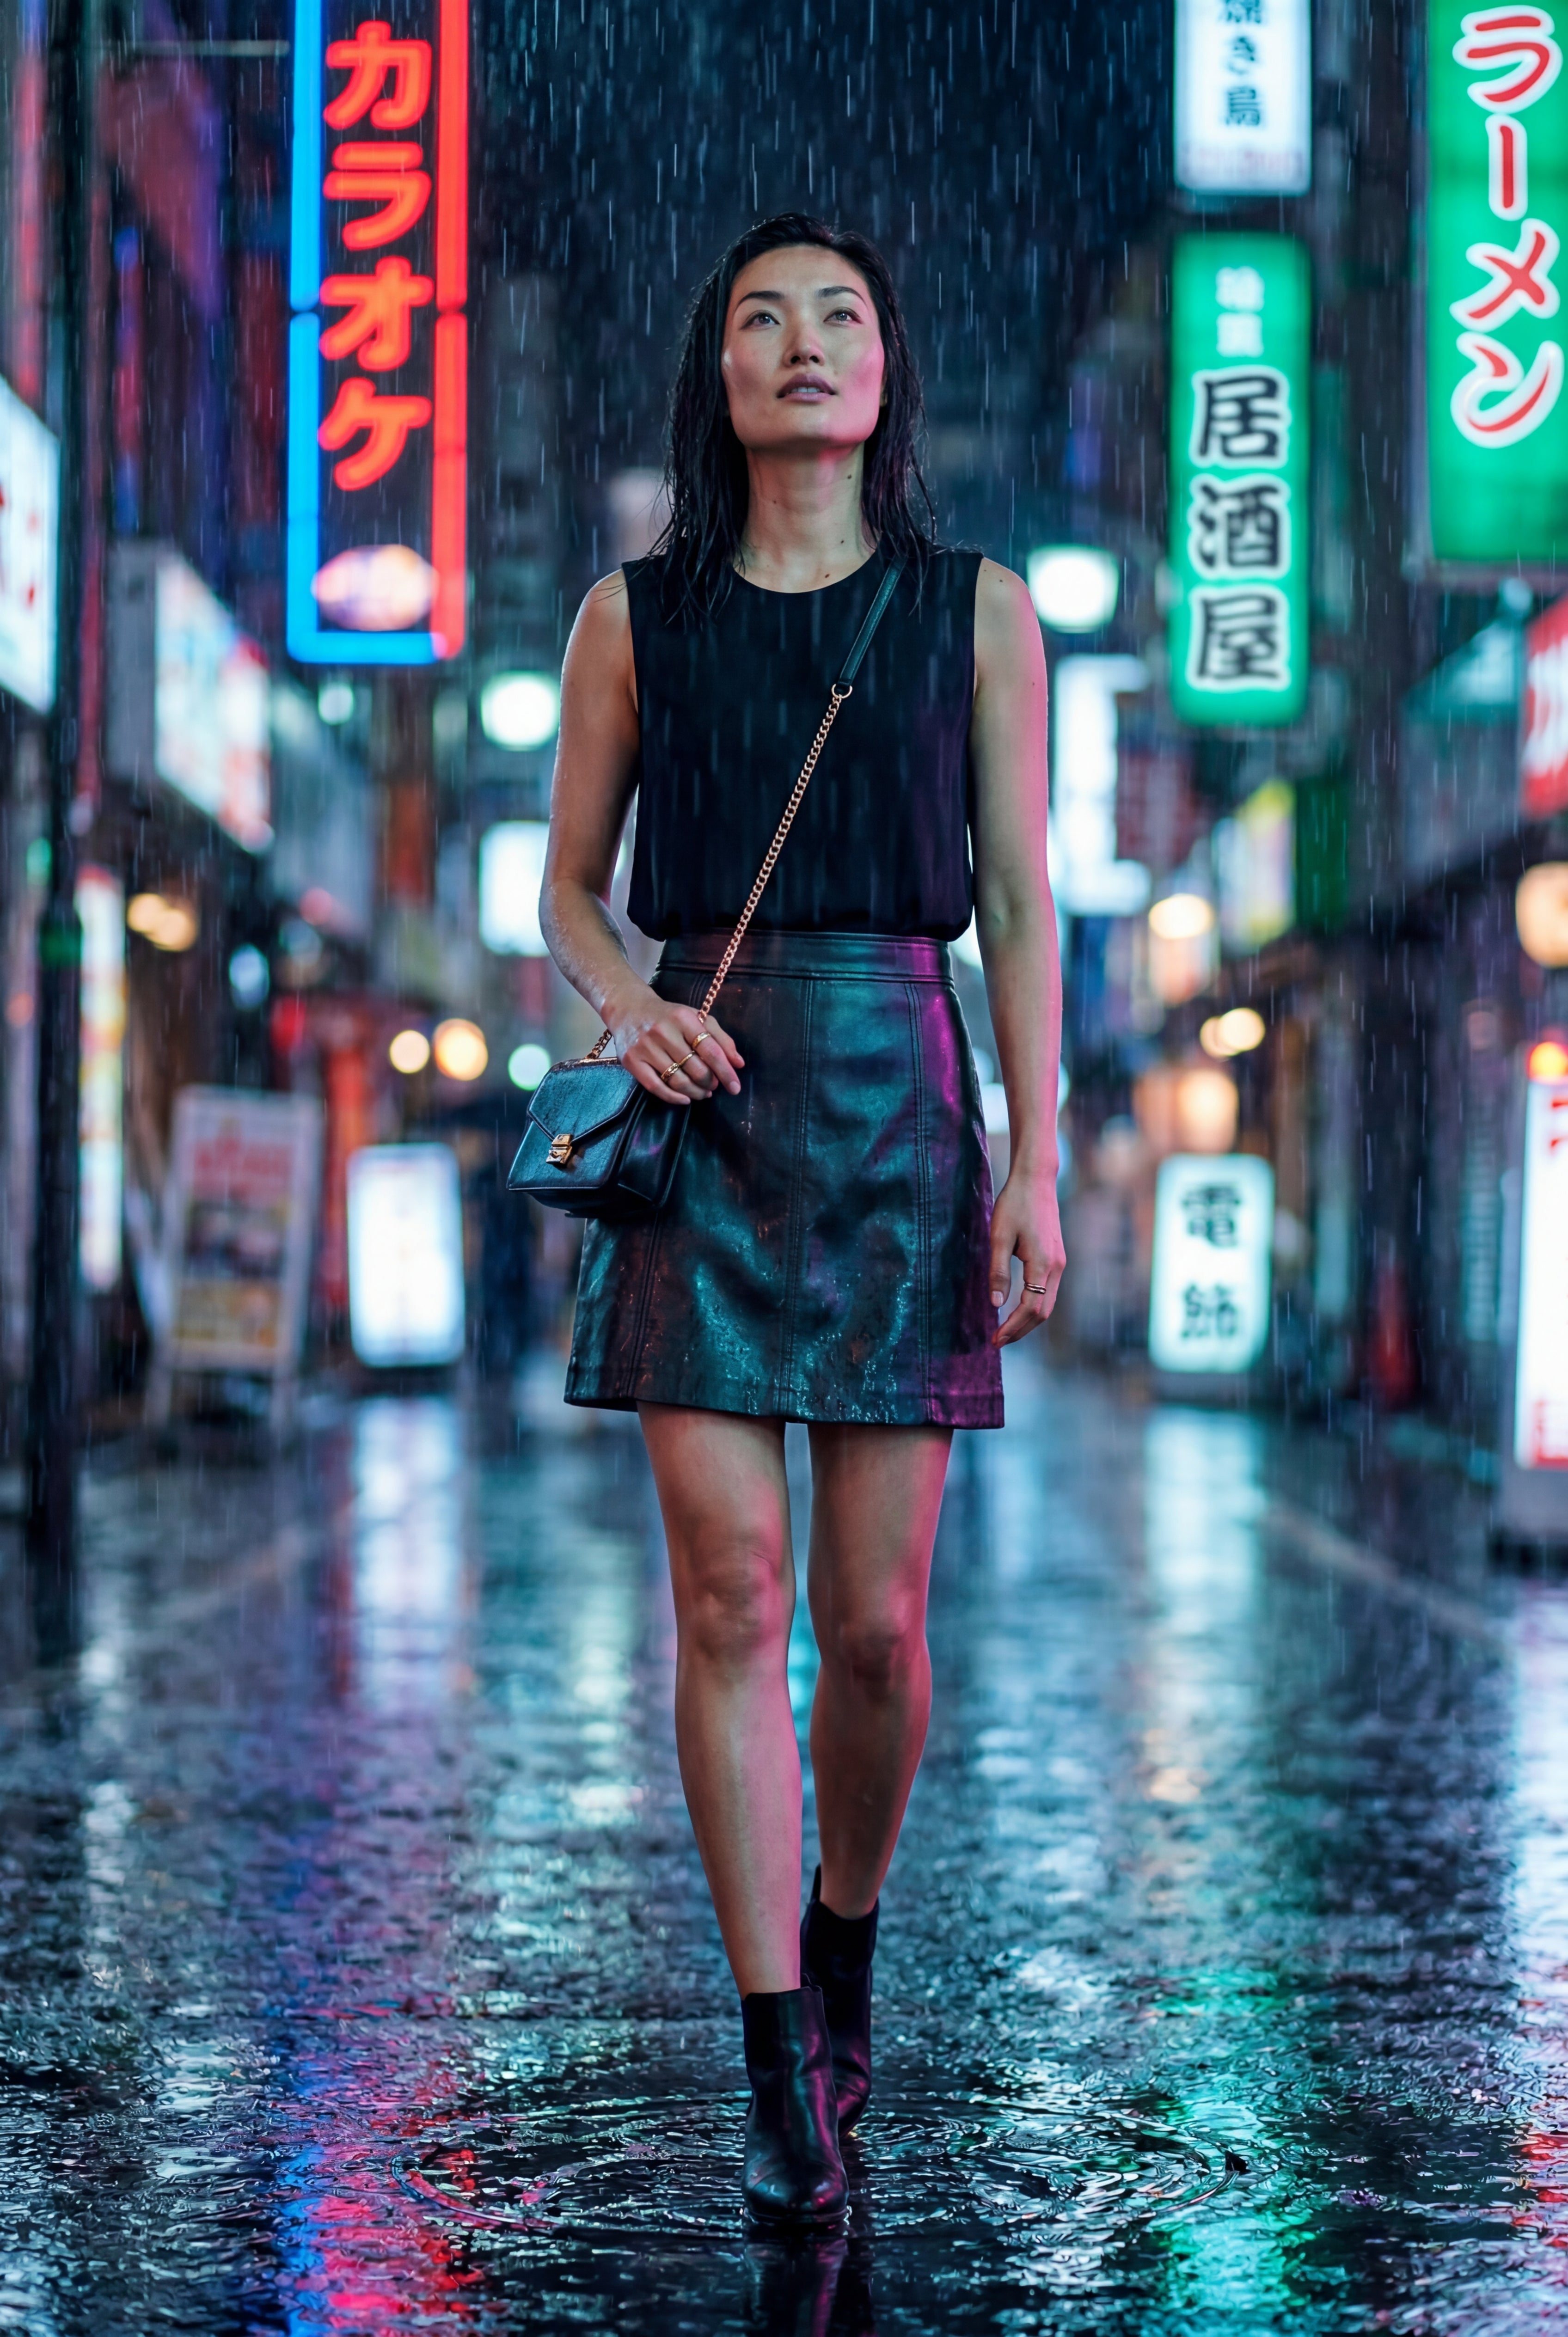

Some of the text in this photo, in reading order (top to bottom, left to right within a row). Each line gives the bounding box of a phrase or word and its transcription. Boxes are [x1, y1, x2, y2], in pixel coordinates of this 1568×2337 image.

[319, 20, 433, 491] カラオケ
[1450, 5, 1563, 448] ラーメン
[1189, 367, 1290, 690] 居酒屋
